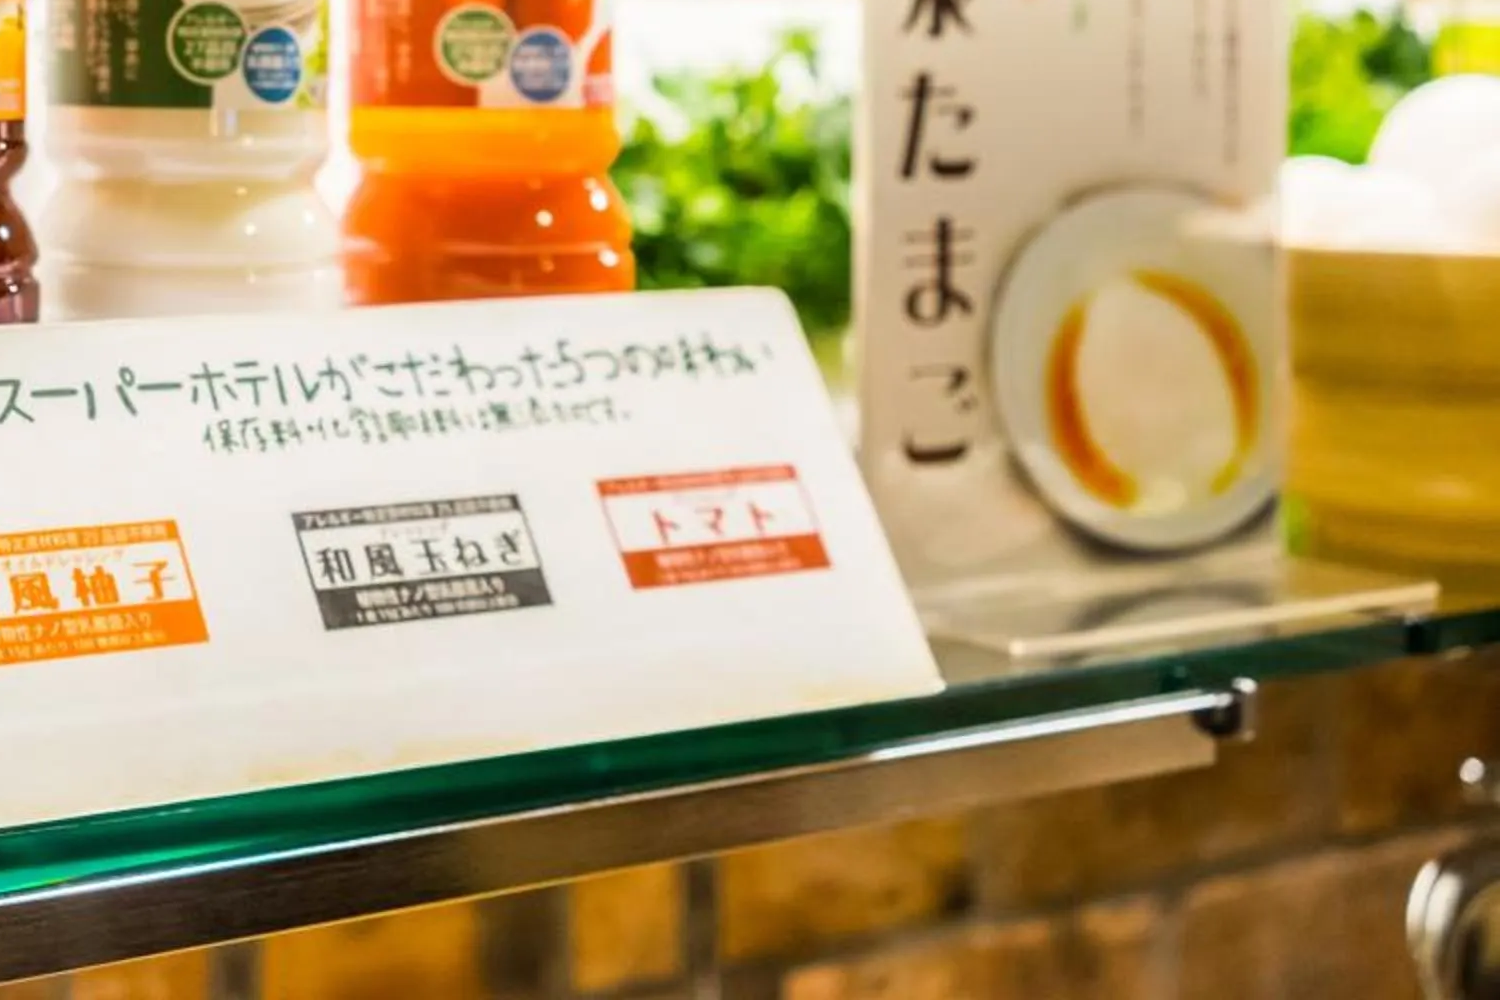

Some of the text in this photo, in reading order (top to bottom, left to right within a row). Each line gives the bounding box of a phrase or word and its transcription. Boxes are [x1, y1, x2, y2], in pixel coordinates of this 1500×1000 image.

[315, 528, 521, 585] 和風玉ねぎ
